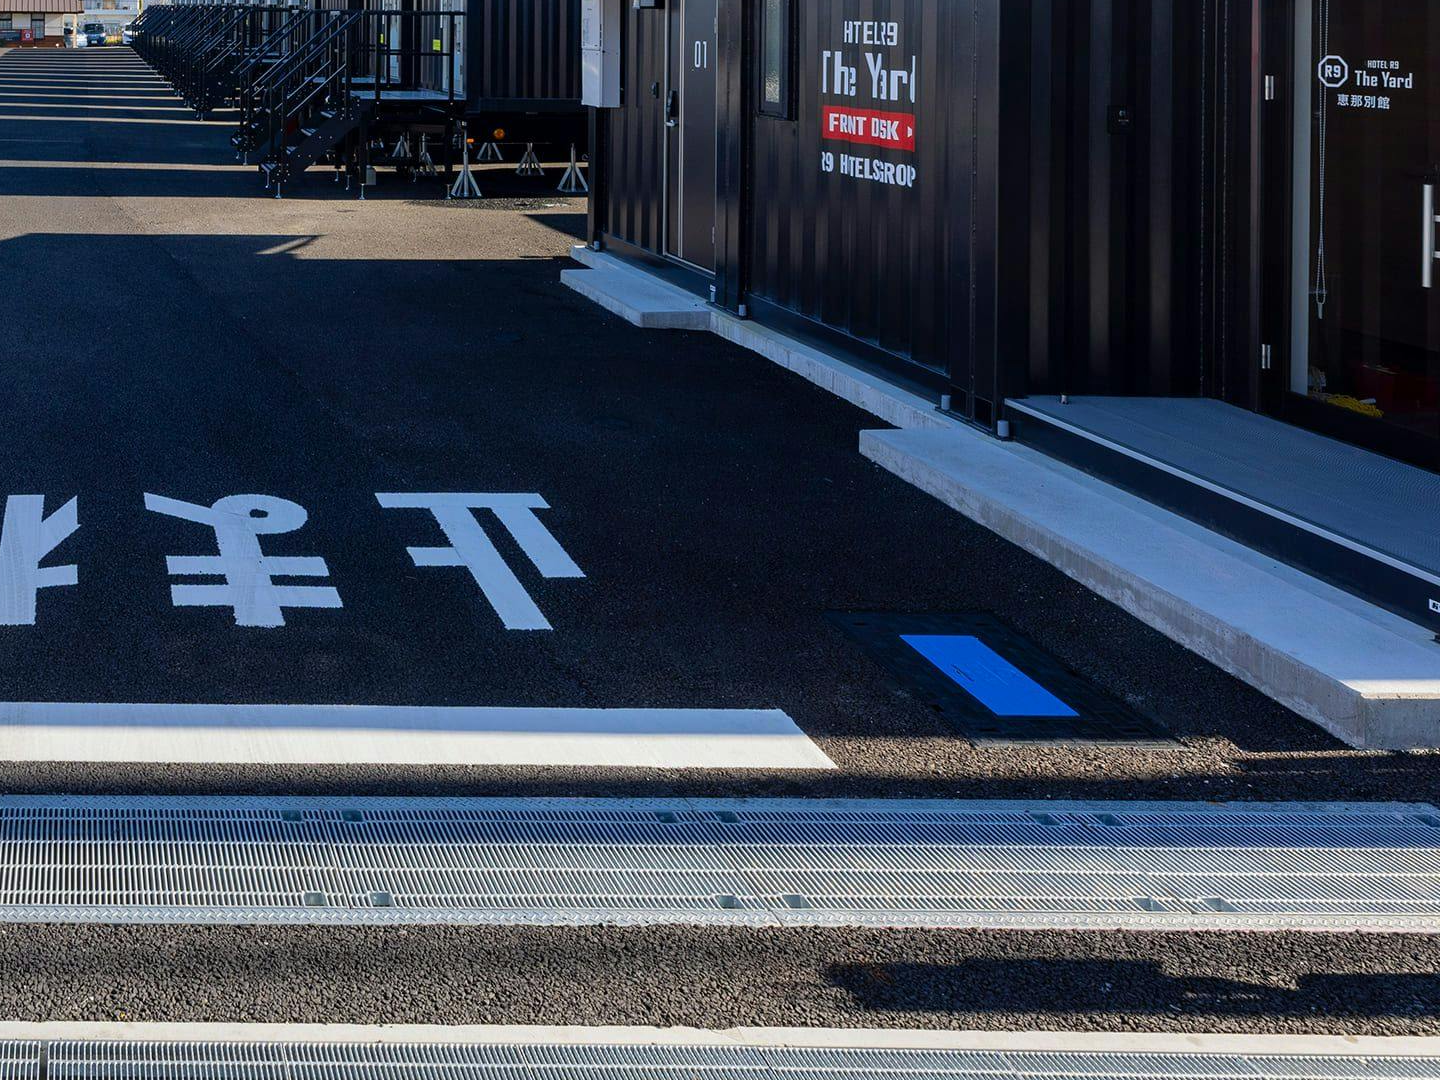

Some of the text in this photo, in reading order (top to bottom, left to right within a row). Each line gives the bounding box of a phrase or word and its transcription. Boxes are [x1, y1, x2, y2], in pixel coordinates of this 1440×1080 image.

[694, 40, 707, 69] 01
[1324, 64, 1342, 78] R9
[1367, 60, 1400, 70] HOTEL R9
[1354, 70, 1413, 89] The Yard
[829, 113, 900, 141] FRNT DSK
